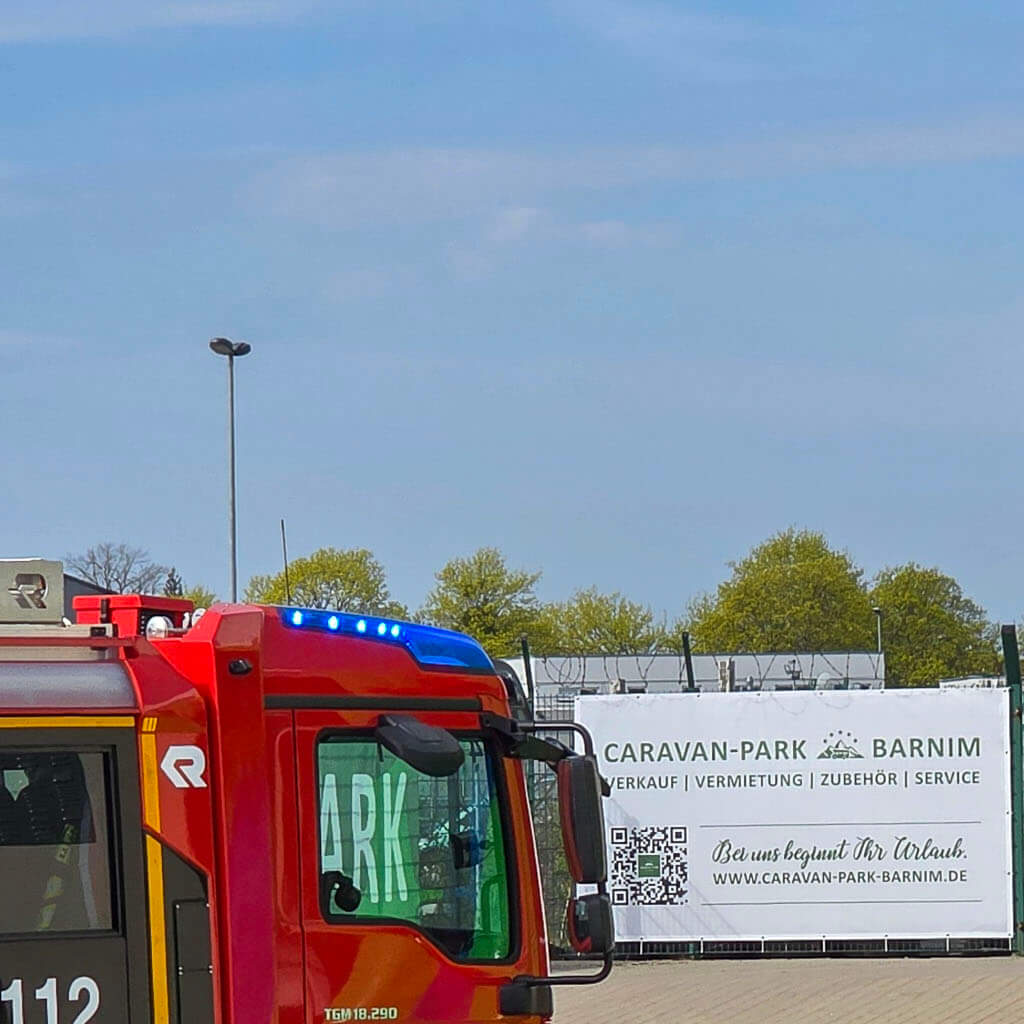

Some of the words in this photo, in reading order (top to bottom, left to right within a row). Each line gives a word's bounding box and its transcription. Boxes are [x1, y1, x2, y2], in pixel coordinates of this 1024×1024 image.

[604, 739, 807, 763] CARAVAN-PARK
[873, 737, 981, 758] BARNIM
[695, 773, 804, 788] VERMIETUNG
[820, 769, 898, 786] ZUBEHÖR
[915, 771, 981, 785] SERVICE
[711, 839, 748, 864] Bei
[751, 850, 781, 863] uns
[783, 840, 850, 870] beginnt
[852, 836, 887, 862] Ihr
[713, 870, 968, 885] WWW.CARAVAN-PARK-BARNIM.DE
[324, 1007, 350, 1021] TGM
[354, 1006, 398, 1020] 18.290
